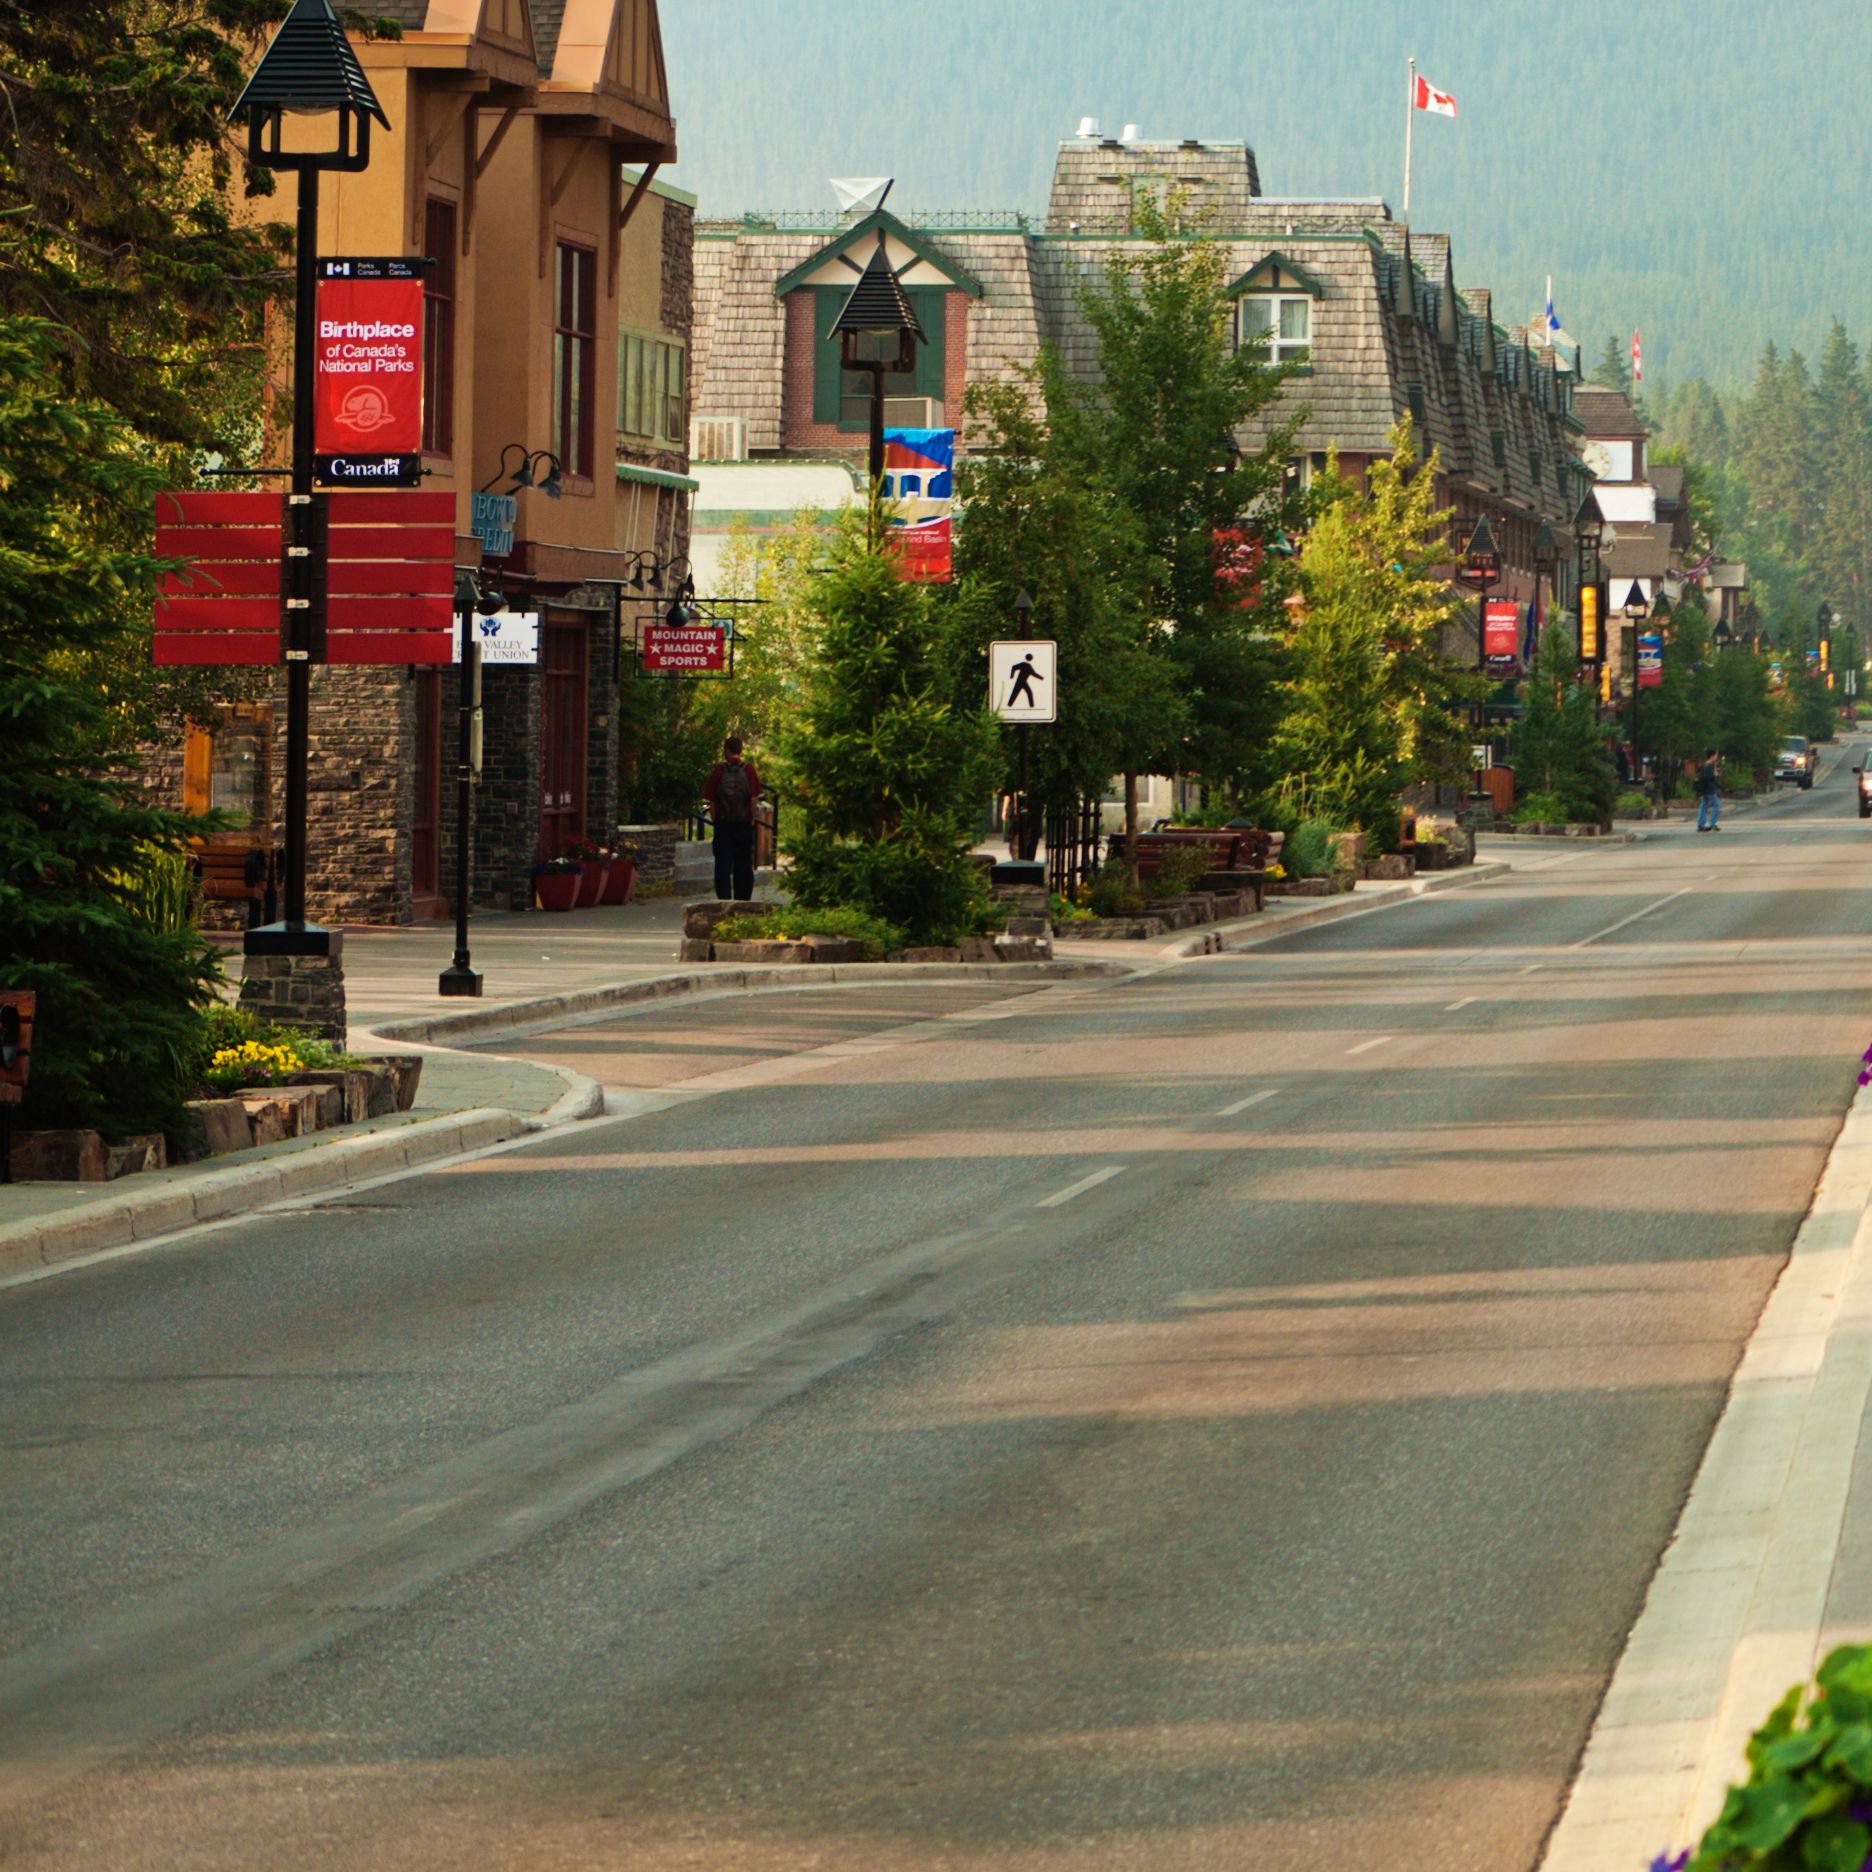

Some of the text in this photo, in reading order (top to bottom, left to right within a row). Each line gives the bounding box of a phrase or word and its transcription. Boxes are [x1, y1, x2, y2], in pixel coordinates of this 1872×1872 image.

[320, 321, 415, 341] Birthplace
[326, 344, 407, 358] of Canada's
[319, 359, 414, 373] National Parks
[330, 458, 400, 476] Canada
[652, 630, 717, 640] MOUNTAIN
[484, 641, 522, 649] VALLEY
[664, 643, 704, 653] MAGIC
[493, 650, 530, 660] UNION
[659, 657, 708, 666] SPORTS
